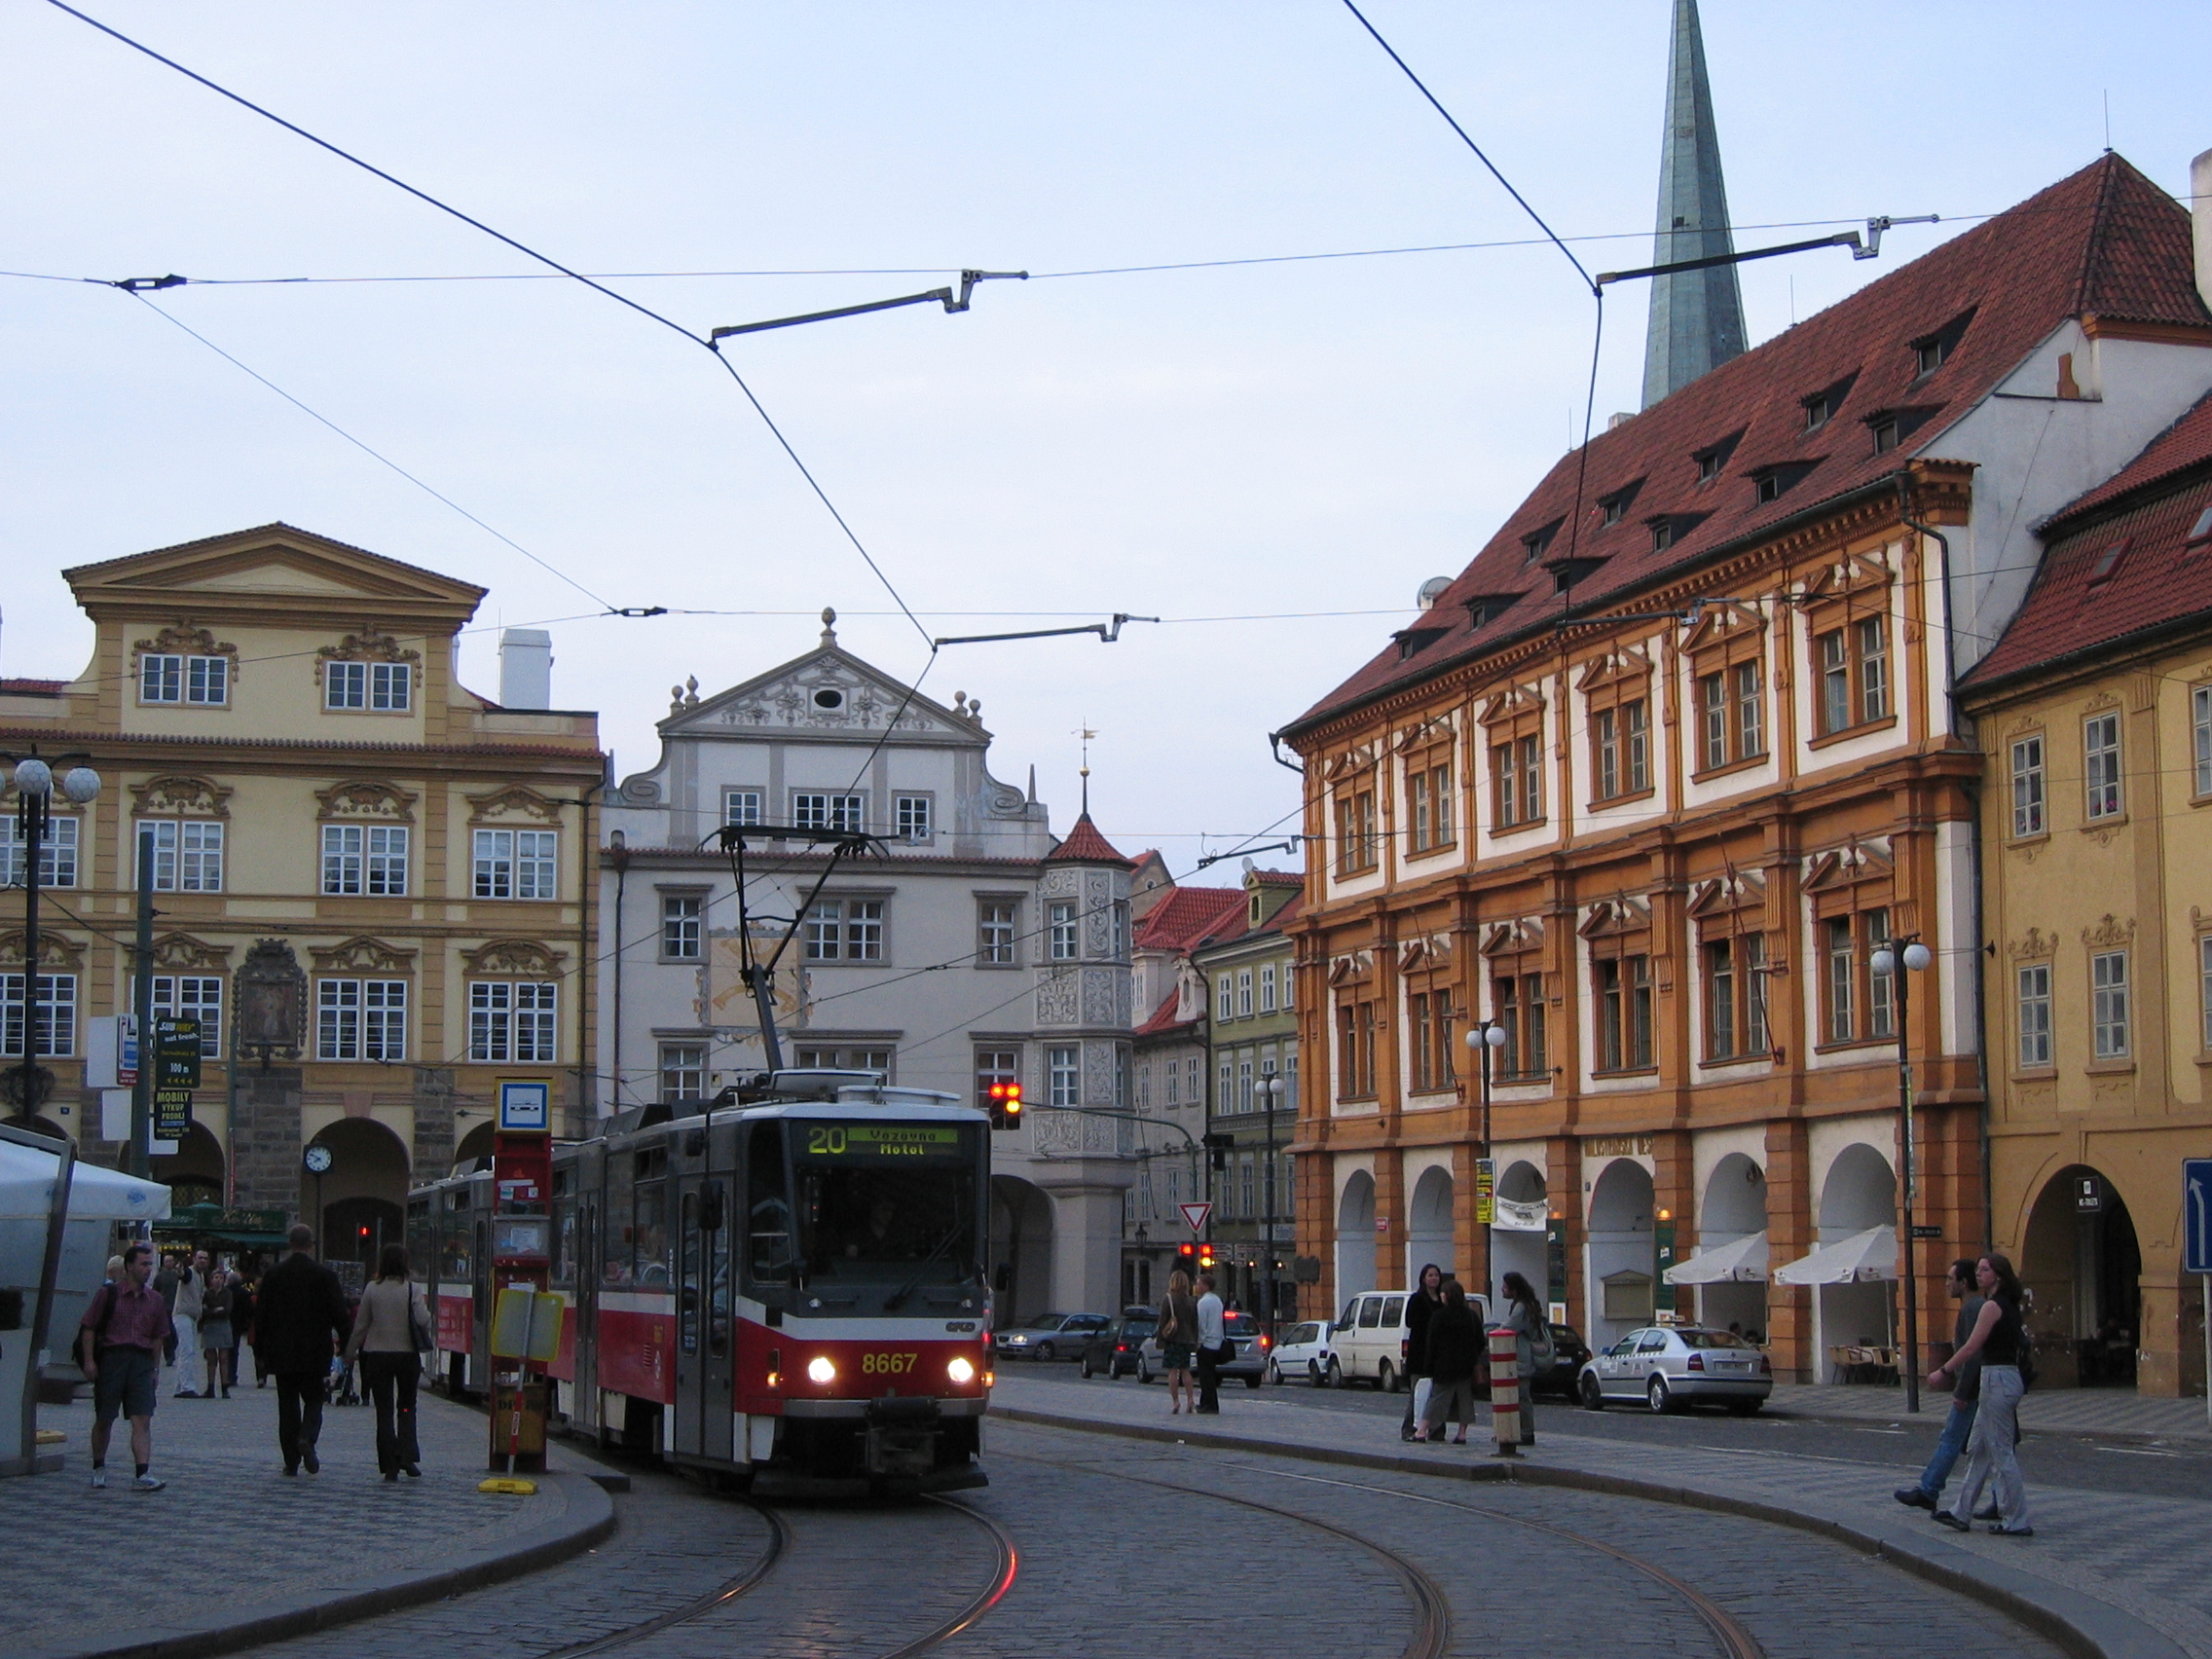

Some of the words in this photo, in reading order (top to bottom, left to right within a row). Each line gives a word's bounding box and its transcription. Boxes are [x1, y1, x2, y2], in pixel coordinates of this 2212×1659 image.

[159, 1021, 195, 1032] SUBWAY
[170, 1062, 182, 1074] 100
[157, 1091, 190, 1102] MOBILY
[808, 1126, 847, 1155] 20
[870, 1129, 937, 1142] Vozovna
[880, 1143, 925, 1156] Motol
[862, 1352, 918, 1375] 8667
